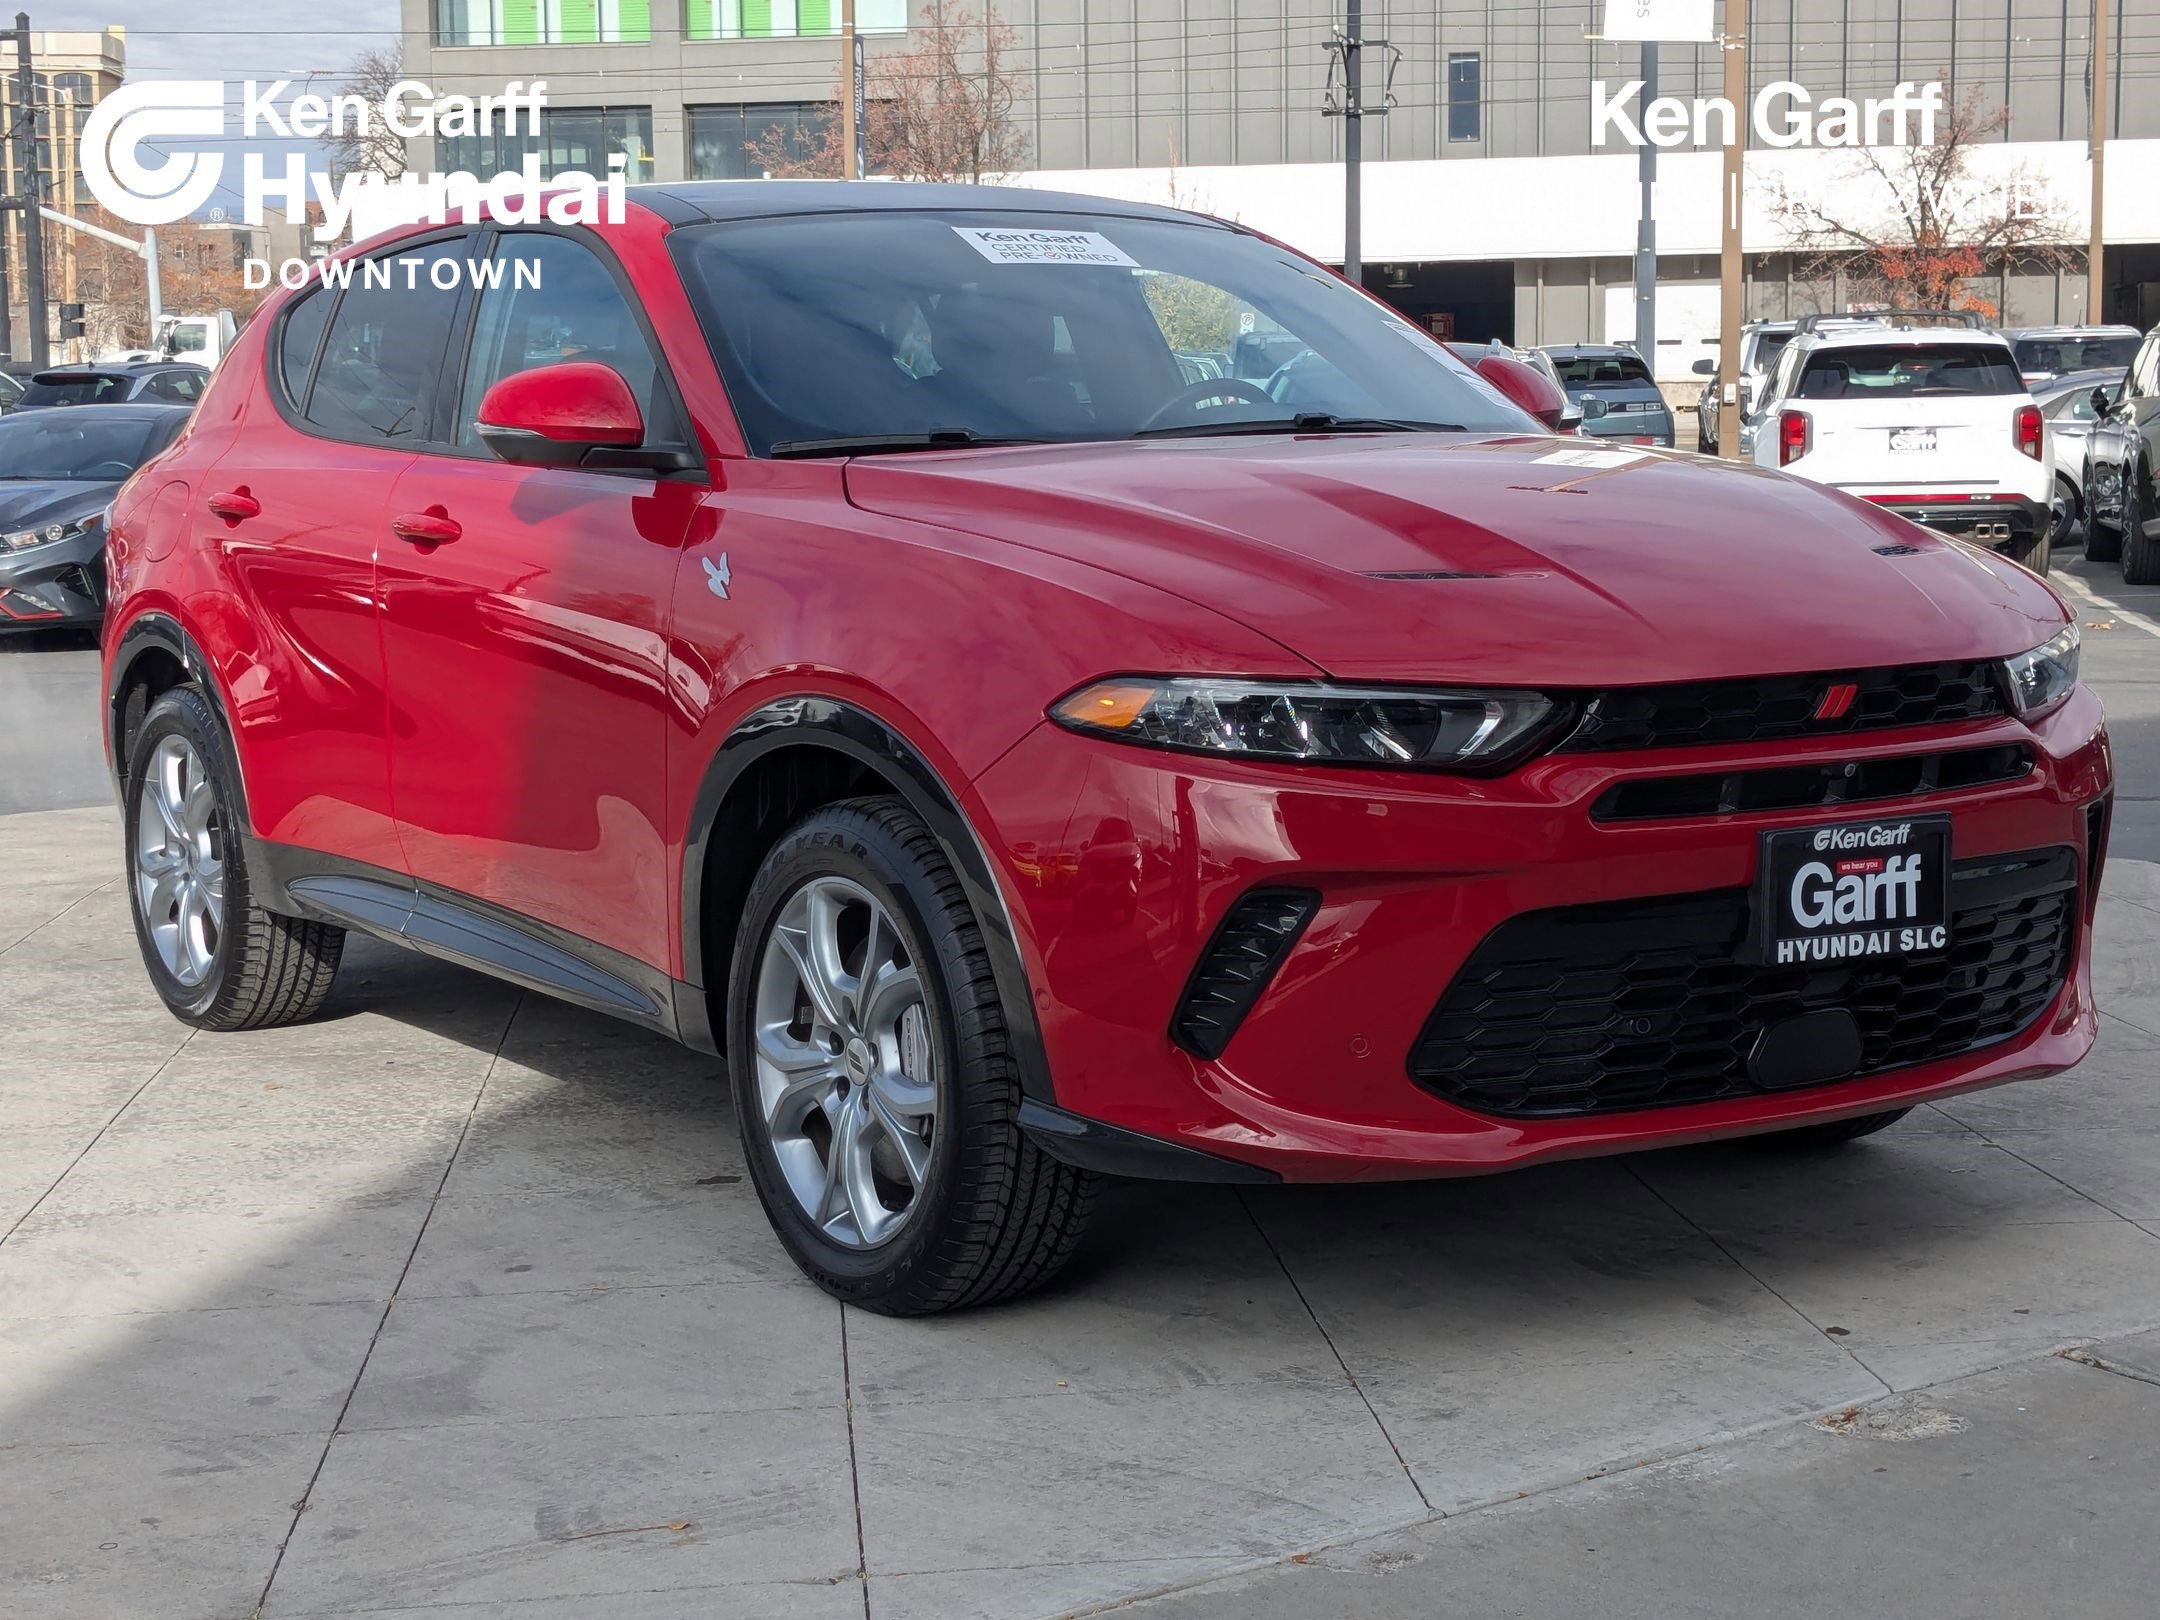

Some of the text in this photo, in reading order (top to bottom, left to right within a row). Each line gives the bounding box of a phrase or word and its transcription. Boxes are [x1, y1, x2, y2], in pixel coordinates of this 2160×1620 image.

[975, 231, 1092, 245] Ken Garff
[991, 243, 1087, 253] CERTIFIED
[1829, 823, 1911, 850] Ken Garff
[1866, 860, 1879, 871] you
[1790, 853, 1922, 929] Garff
[1777, 925, 1947, 964] HYUNDAI SLC
